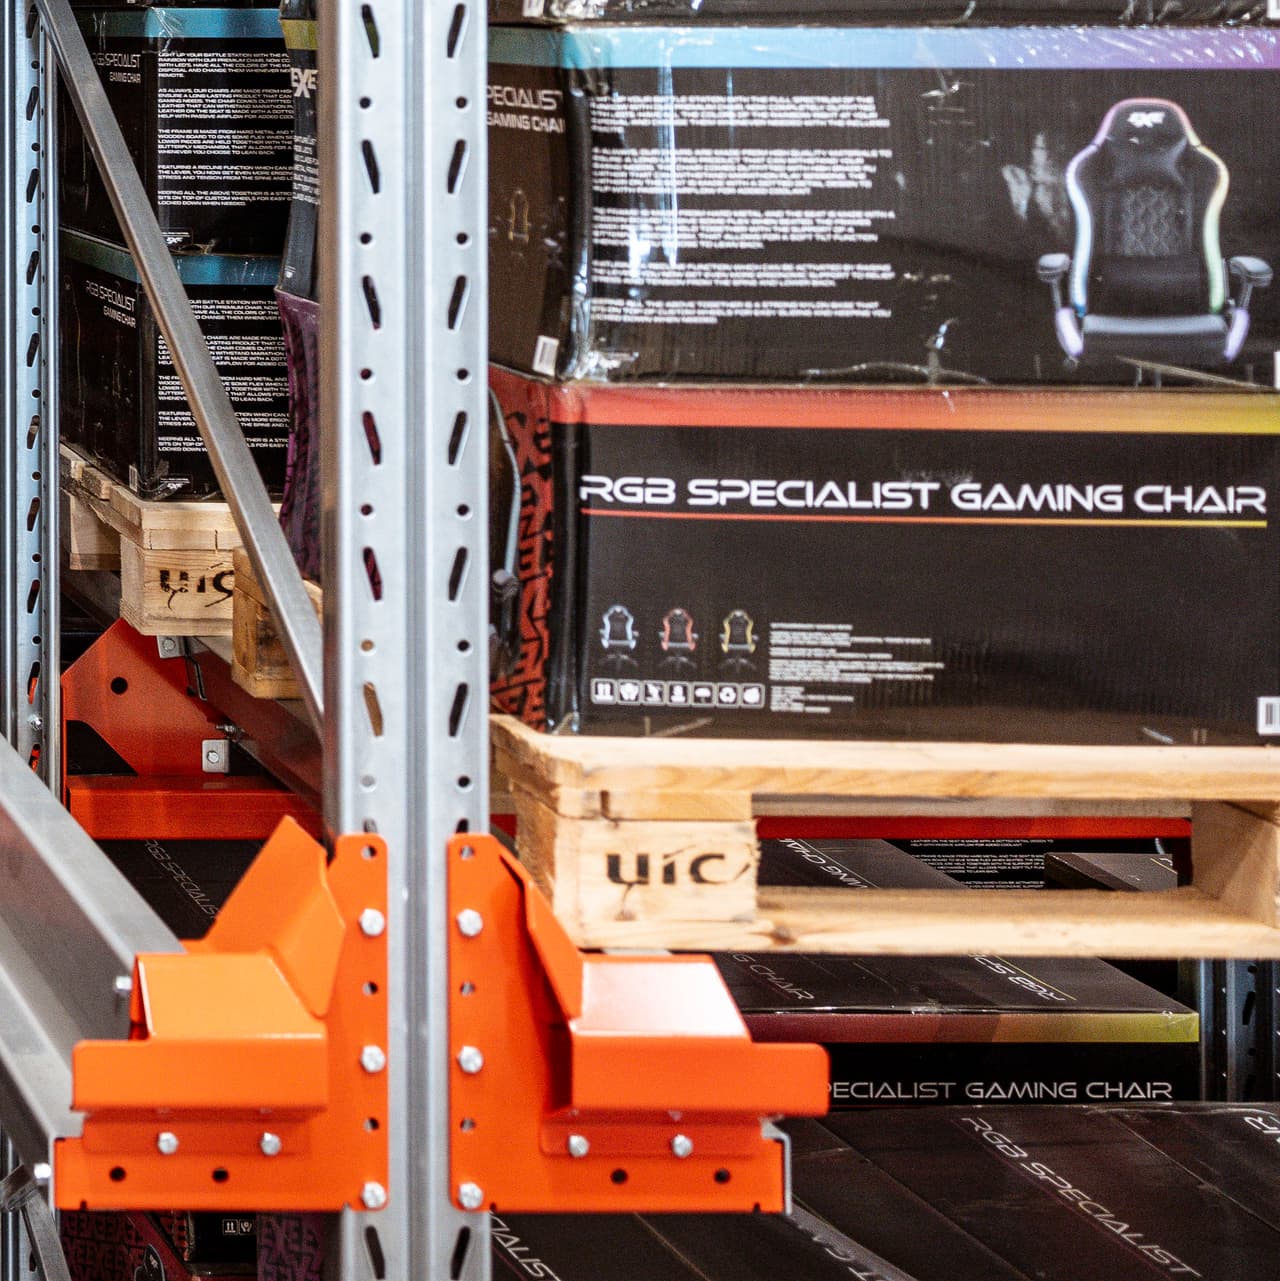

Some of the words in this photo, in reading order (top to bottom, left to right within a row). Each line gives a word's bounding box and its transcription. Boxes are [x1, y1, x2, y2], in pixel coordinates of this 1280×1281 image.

[104, 54, 141, 68] SPECIALIST
[86, 282, 100, 299] RGB
[99, 285, 136, 312] SPECIALIST
[579, 474, 678, 507] RGB
[686, 477, 940, 511] SPECIALIST
[950, 481, 1125, 514] GAMING
[1133, 484, 1268, 517] CHAIR
[747, 960, 815, 1000] CHAIR
[829, 1081, 956, 1099] PECIALIST
[965, 1081, 1077, 1099] GAMING
[1085, 1081, 1173, 1100] CHAIR
[961, 1115, 1029, 1159] RGB
[1020, 1161, 1204, 1279] SPECIALIST
